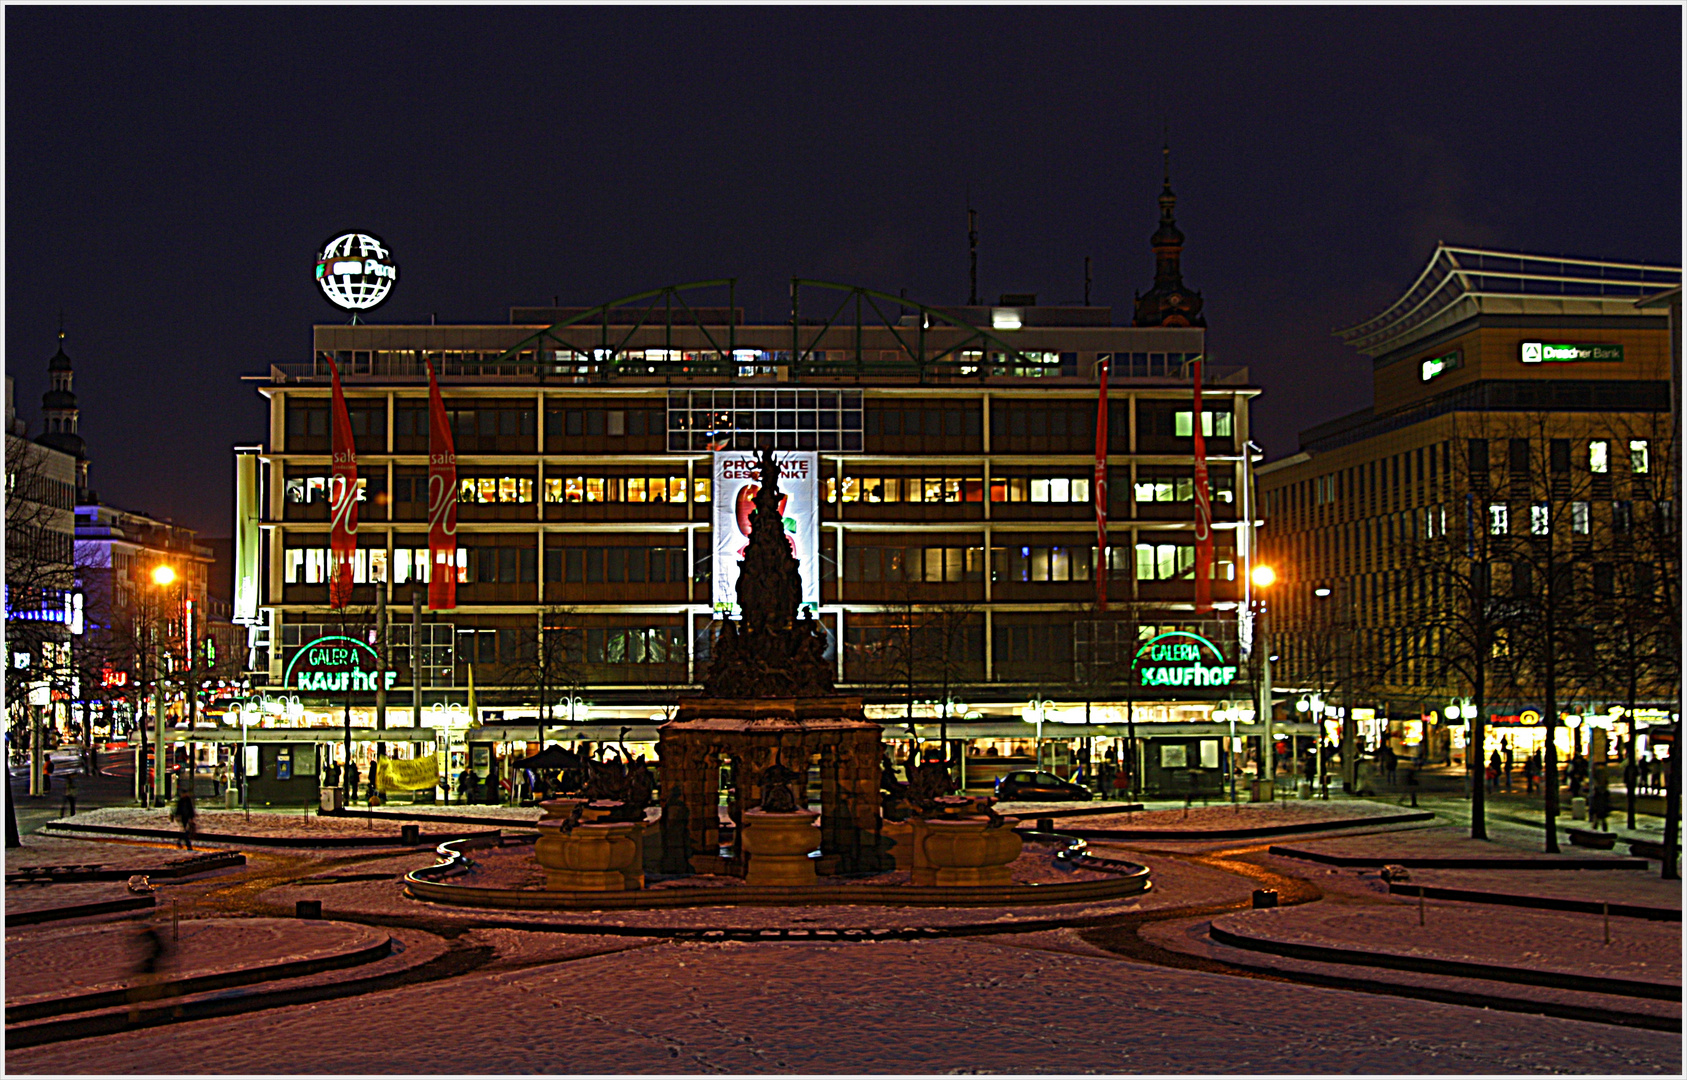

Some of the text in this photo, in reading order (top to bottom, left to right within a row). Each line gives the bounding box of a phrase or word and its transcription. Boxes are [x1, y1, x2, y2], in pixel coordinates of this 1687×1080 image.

[1593, 347, 1620, 359] Bank
[334, 448, 357, 464] sale
[431, 450, 456, 465] sale
[723, 460, 809, 471] PRONTE
[723, 470, 809, 480] GESNKT
[308, 648, 360, 666] GALERA
[1151, 644, 1201, 662] GALERIA
